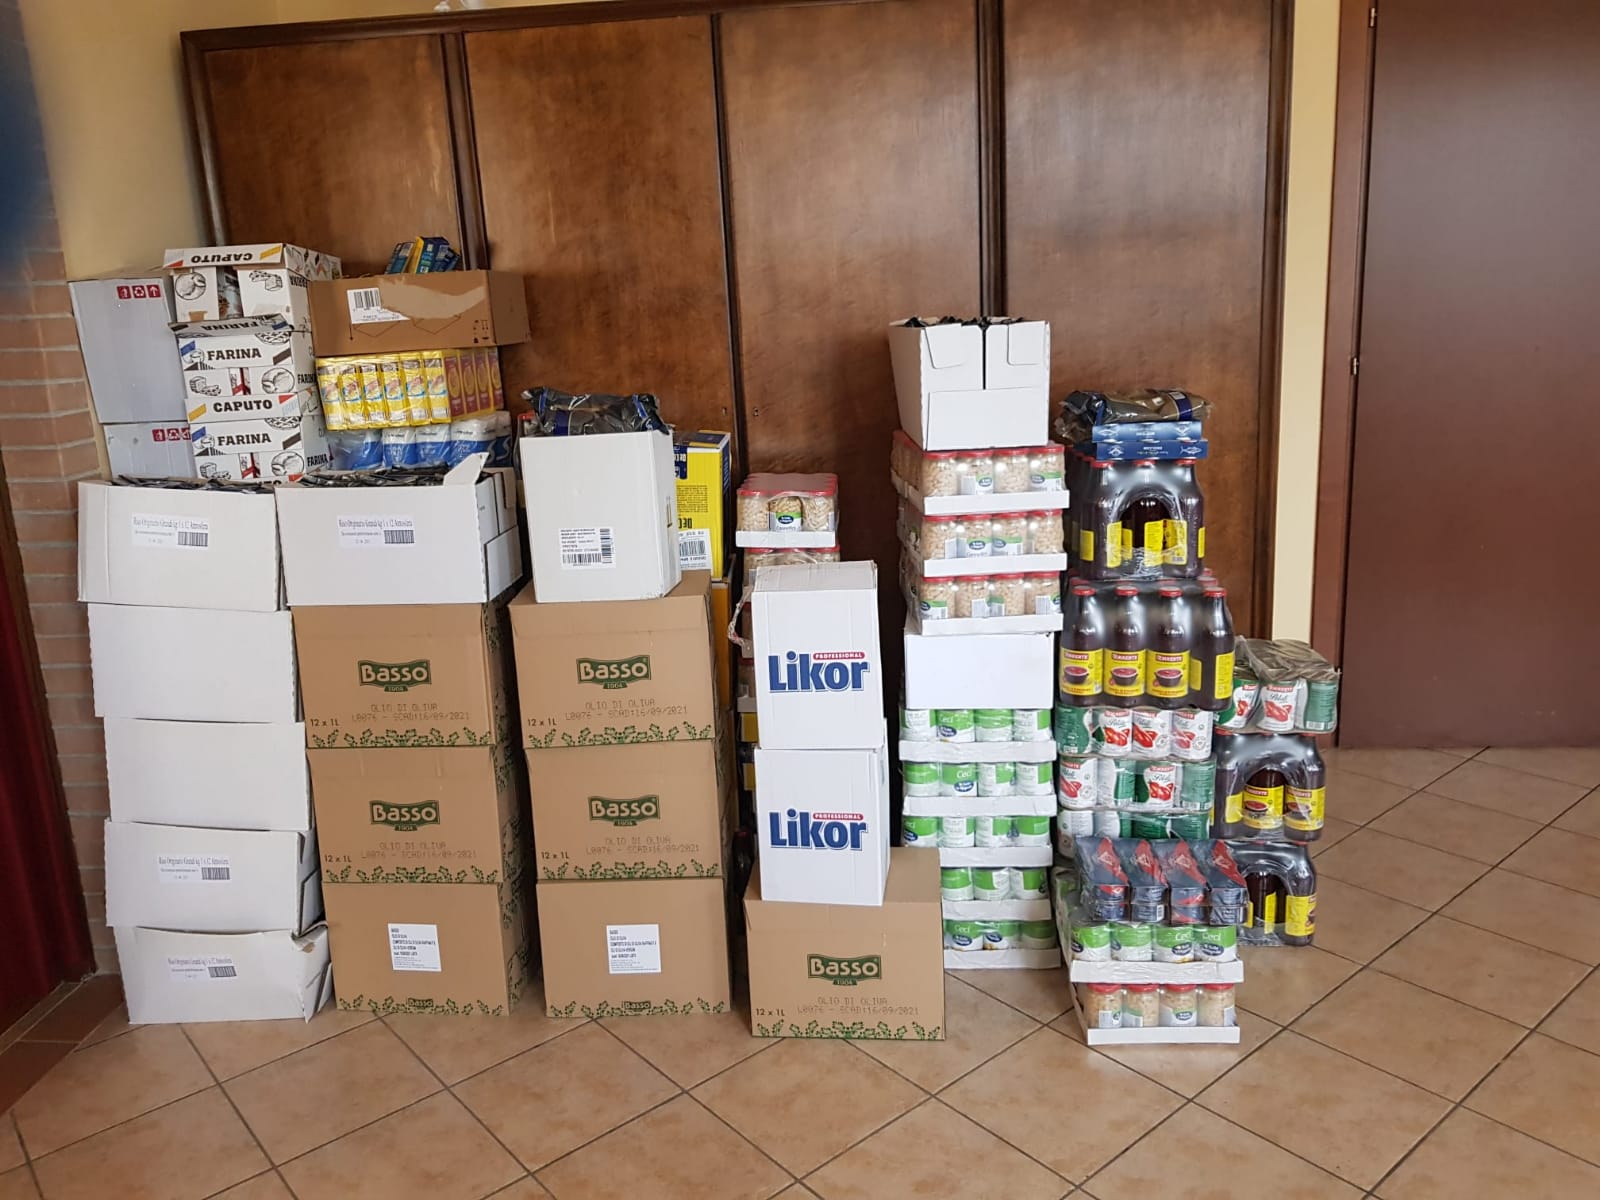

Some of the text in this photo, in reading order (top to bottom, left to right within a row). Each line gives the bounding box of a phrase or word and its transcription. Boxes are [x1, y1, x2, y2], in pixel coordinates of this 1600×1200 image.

[191, 253, 253, 264] CAPUTO
[201, 320, 258, 331] FARINA
[207, 347, 262, 361] FARINA
[213, 399, 273, 413] CAPUTO
[217, 433, 272, 446] FARINA
[306, 453, 329, 467] FARINA
[815, 652, 863, 660] PROFESSIONAL
[361, 664, 428, 683] Basso
[579, 662, 648, 681] Basso
[768, 651, 870, 692] Likor
[584, 700, 607, 711] OLIO
[612, 699, 623, 709] DI
[310, 718, 320, 727] 12
[527, 718, 537, 727] 12
[372, 804, 437, 822] Basso
[591, 800, 657, 817] Basso
[814, 812, 861, 820] PROFESSIONAL
[769, 809, 868, 851] Likor
[324, 855, 333, 863] 12
[541, 851, 550, 860] 12
[810, 957, 878, 976] Basso
[817, 996, 840, 1005] OLIO
[844, 996, 854, 1005] DI
[755, 1008, 765, 1016] 12
